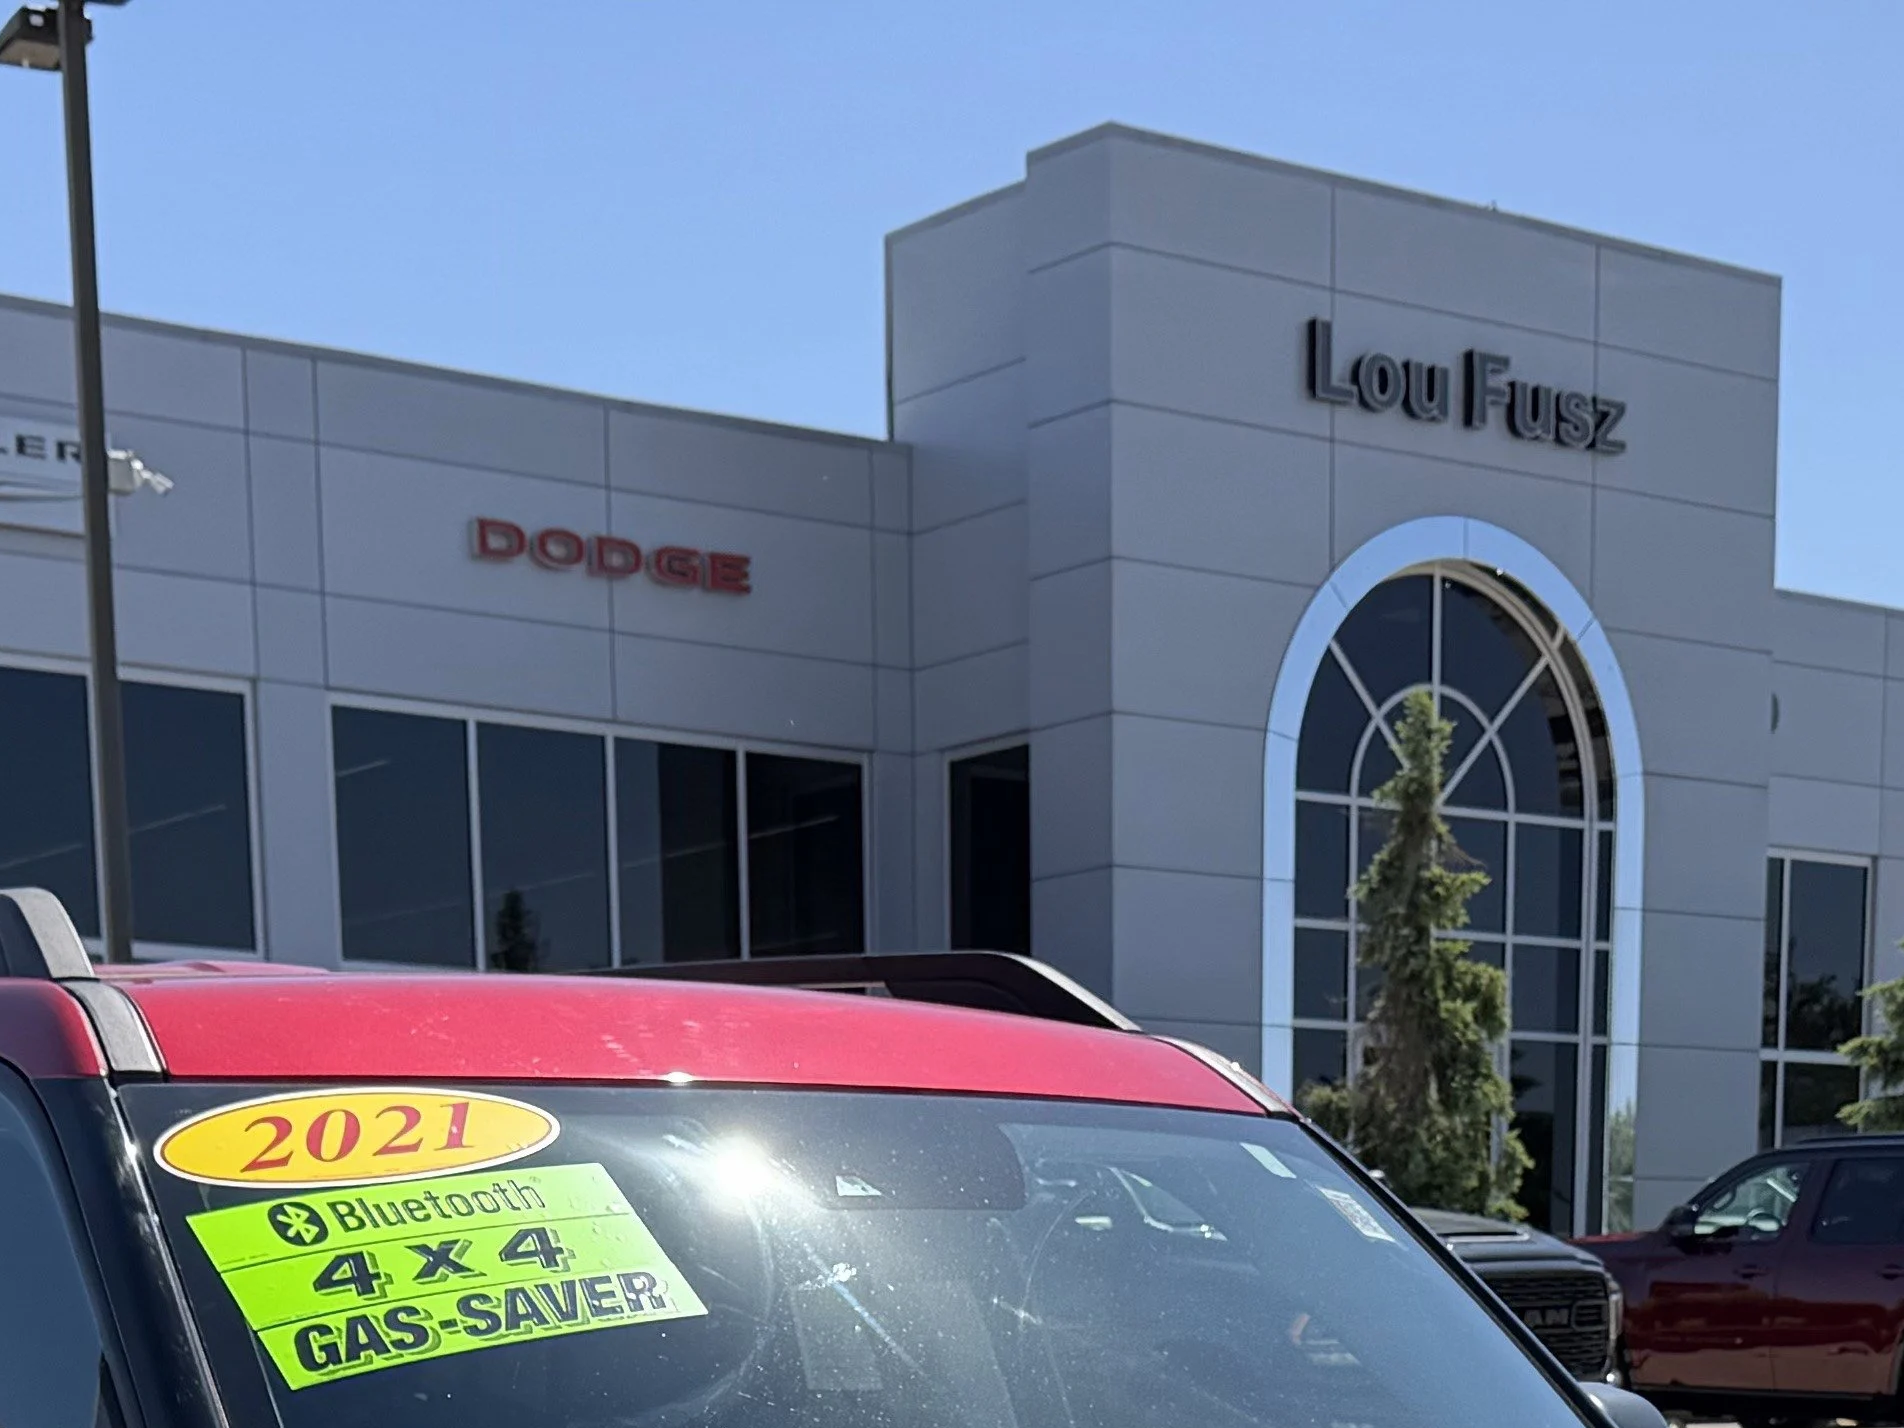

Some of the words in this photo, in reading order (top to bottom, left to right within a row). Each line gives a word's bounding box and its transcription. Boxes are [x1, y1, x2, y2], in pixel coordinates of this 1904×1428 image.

[1306, 316, 1449, 423] Lou
[1462, 348, 1627, 454] Fusz
[467, 515, 752, 596] DODGE
[240, 1101, 475, 1174] 2021
[325, 1179, 547, 1233] Bluetooth
[311, 1250, 391, 1299] 4
[498, 1227, 574, 1272] 4
[294, 1271, 668, 1376] GAS-SAVER
